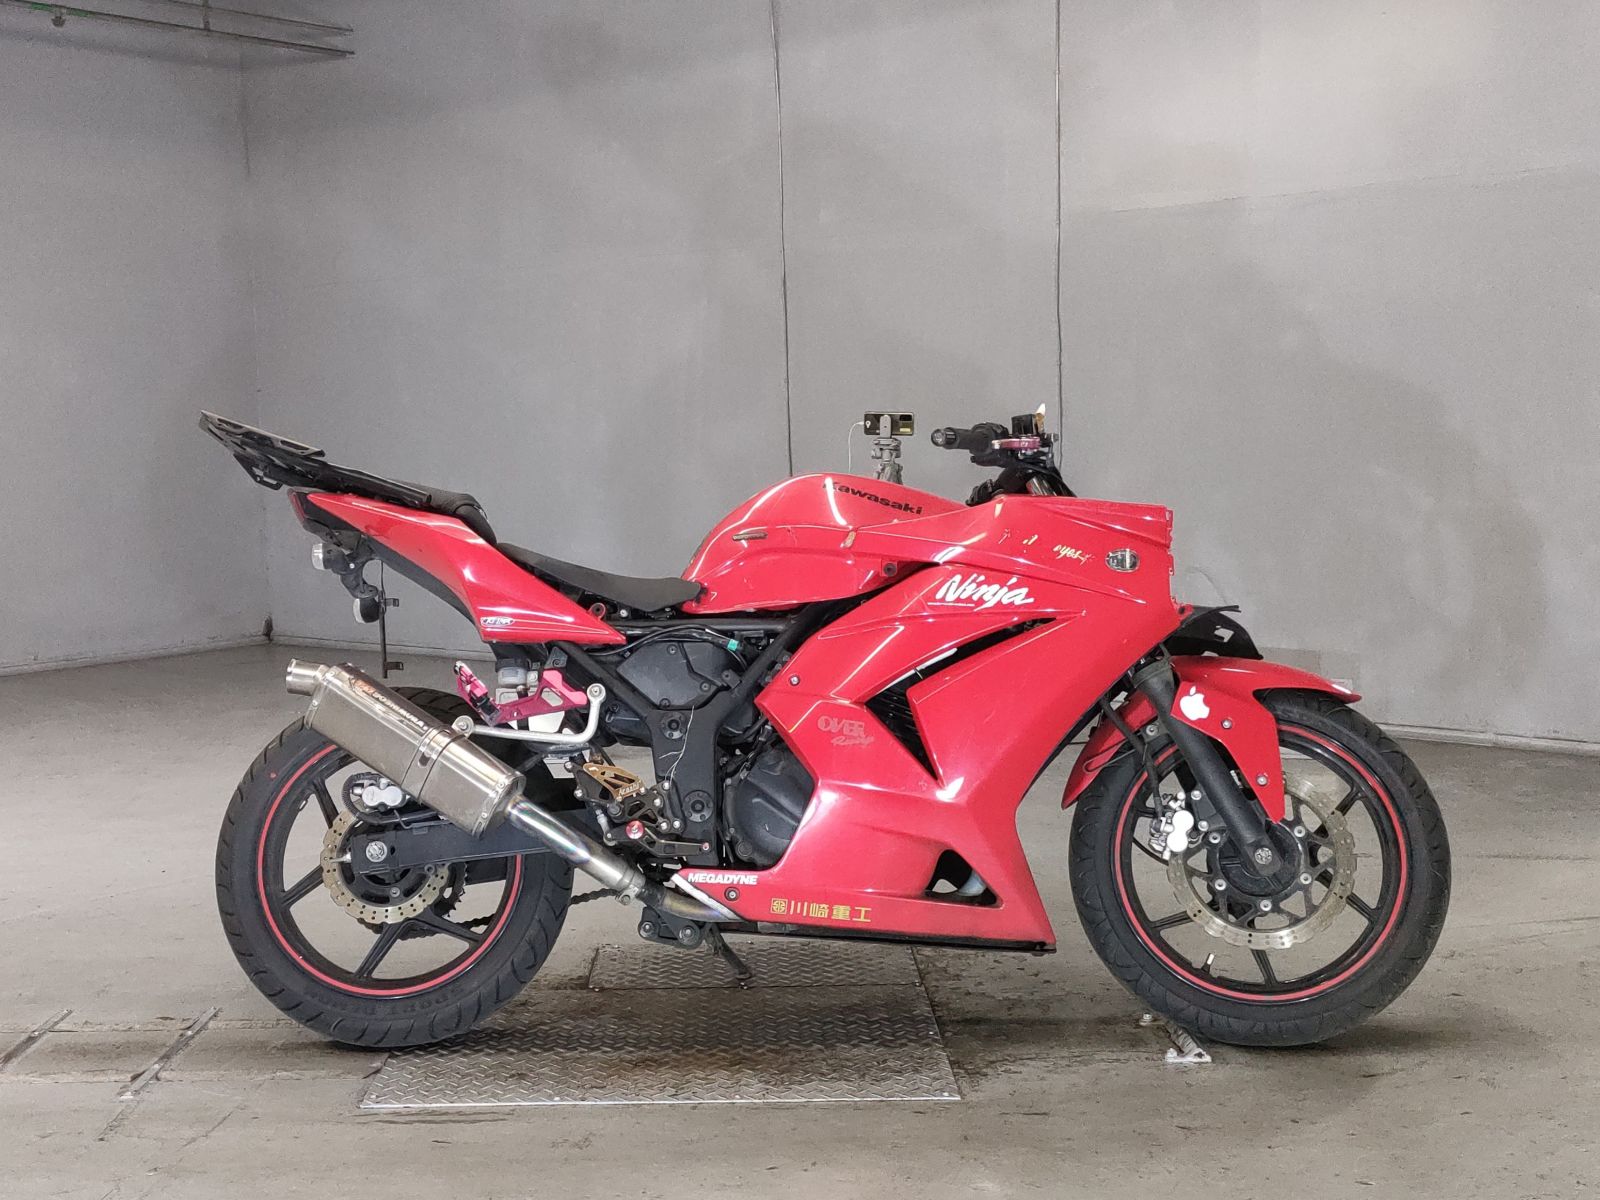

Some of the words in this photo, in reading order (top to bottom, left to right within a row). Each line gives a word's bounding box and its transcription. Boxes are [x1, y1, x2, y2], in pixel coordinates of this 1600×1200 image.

[935, 573, 1035, 611] Ninja
[688, 872, 758, 885] MEGADYNE
[789, 901, 872, 923] 川崎重工
